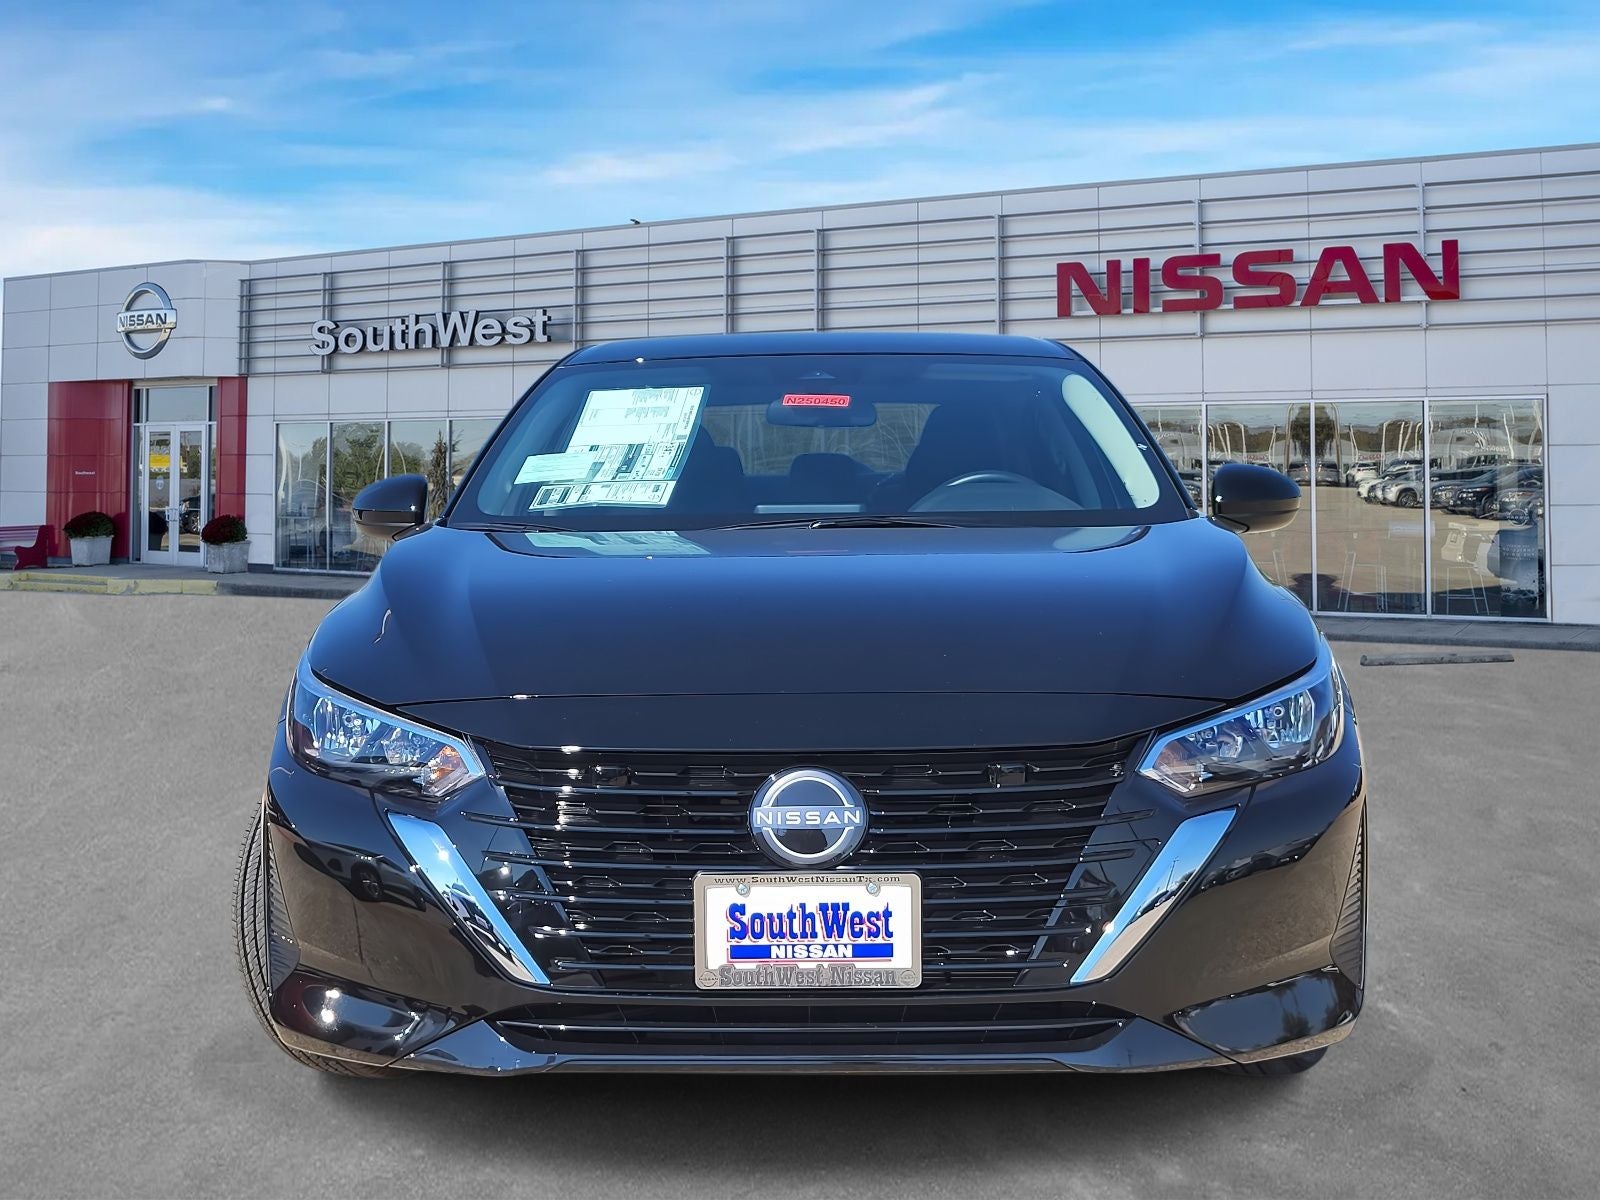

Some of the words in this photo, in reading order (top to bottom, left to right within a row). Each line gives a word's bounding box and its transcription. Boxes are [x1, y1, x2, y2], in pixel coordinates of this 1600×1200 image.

[1056, 239, 1461, 319] NISSAN
[118, 312, 168, 328] NISSAN
[309, 308, 552, 356] SouthWest
[786, 396, 846, 405] N250450
[756, 810, 861, 825] NISSAN
[727, 902, 894, 942] SouthWest
[770, 943, 853, 959] NISSAN
[718, 965, 826, 987] SouthWest
[829, 965, 897, 987] Nissan
